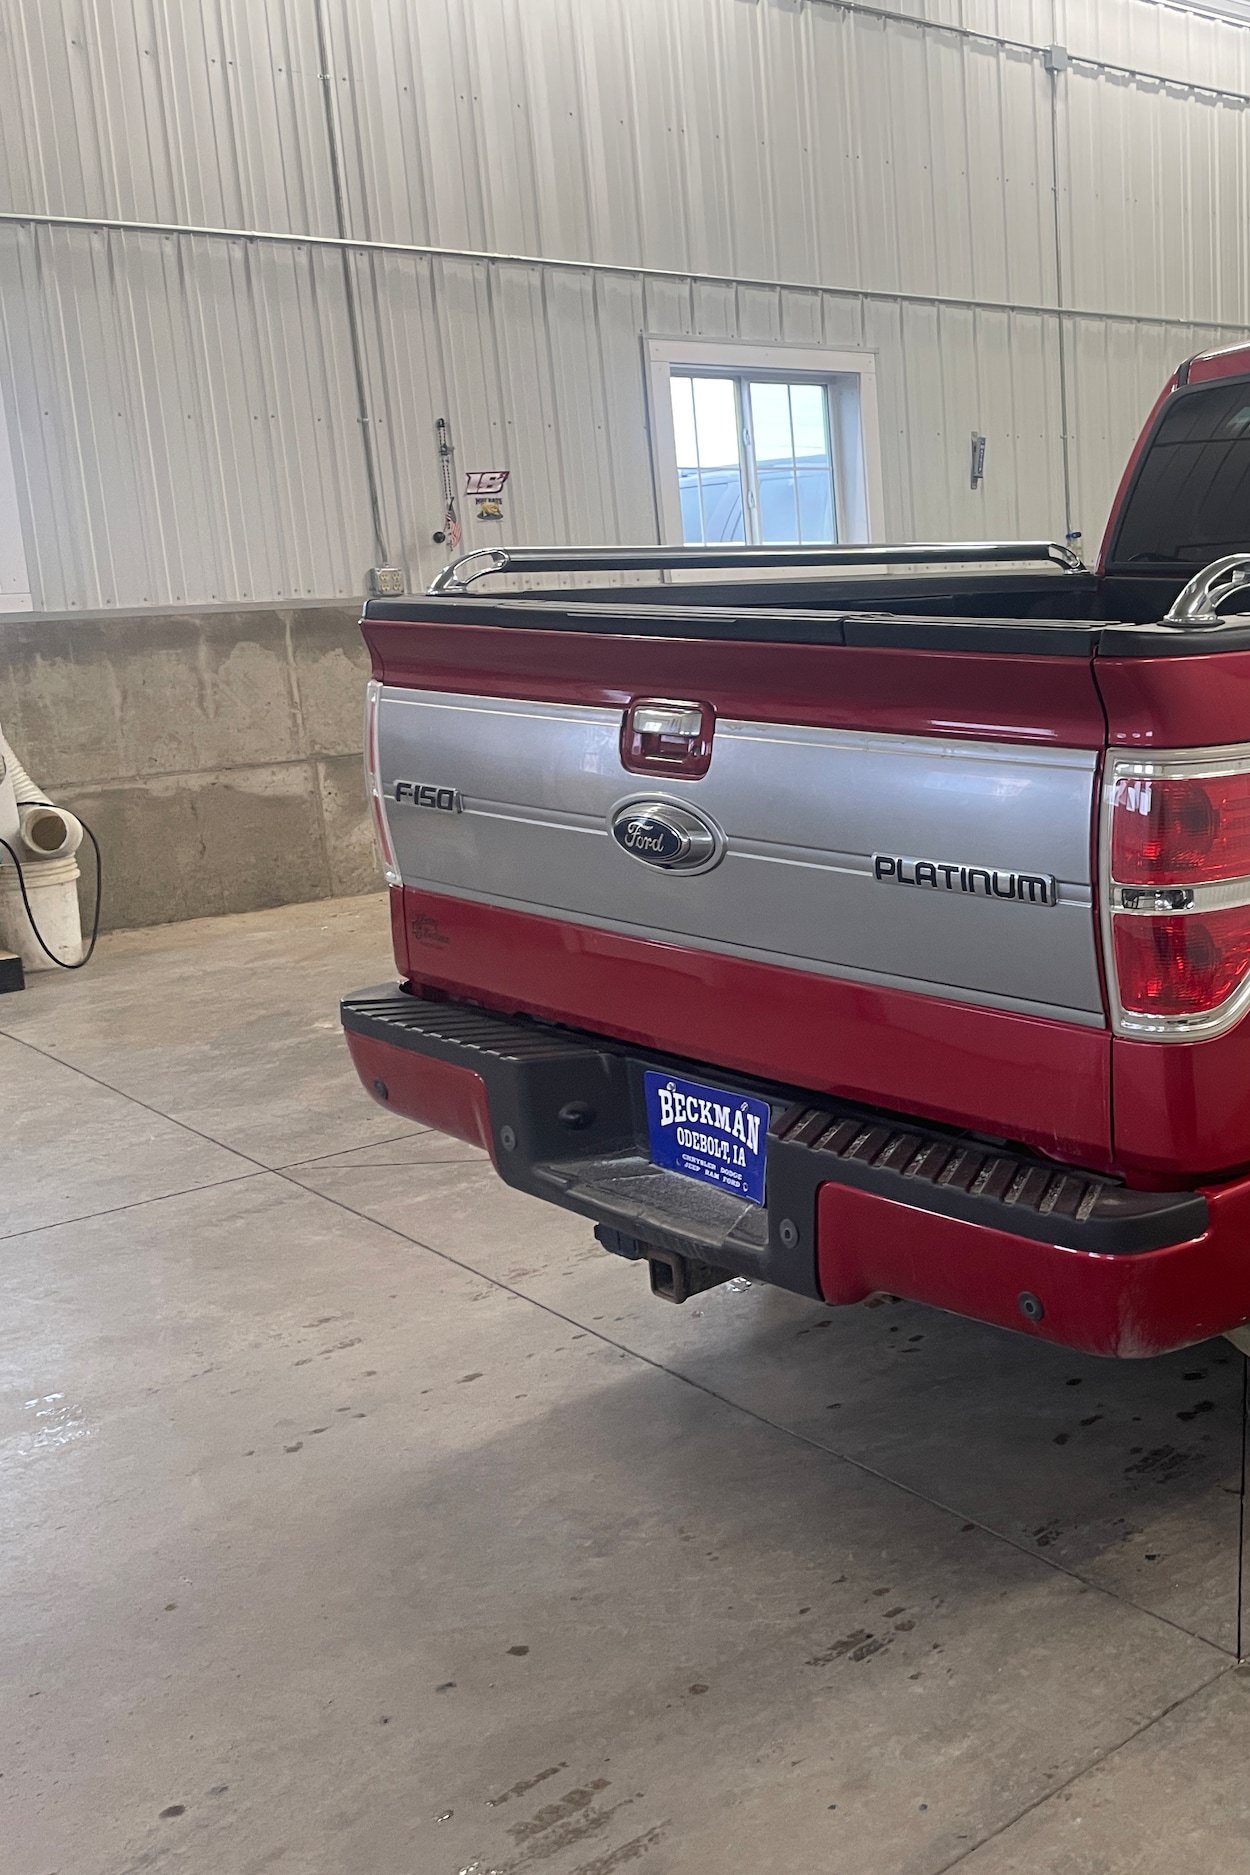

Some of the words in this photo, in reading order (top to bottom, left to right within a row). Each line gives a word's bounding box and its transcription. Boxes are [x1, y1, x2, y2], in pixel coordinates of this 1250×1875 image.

[396, 782, 455, 811] F-150
[625, 822, 664, 852] Ford
[874, 856, 1048, 904] PLATINUM
[658, 1088, 760, 1156] BECKMAN
[677, 1127, 730, 1164] ODEBOLT,
[732, 1145, 746, 1167] IA
[684, 1162, 701, 1172] JEEP
[705, 1169, 719, 1180] RAM
[722, 1176, 741, 1188] FORD
[720, 1167, 743, 1181] DODGE
